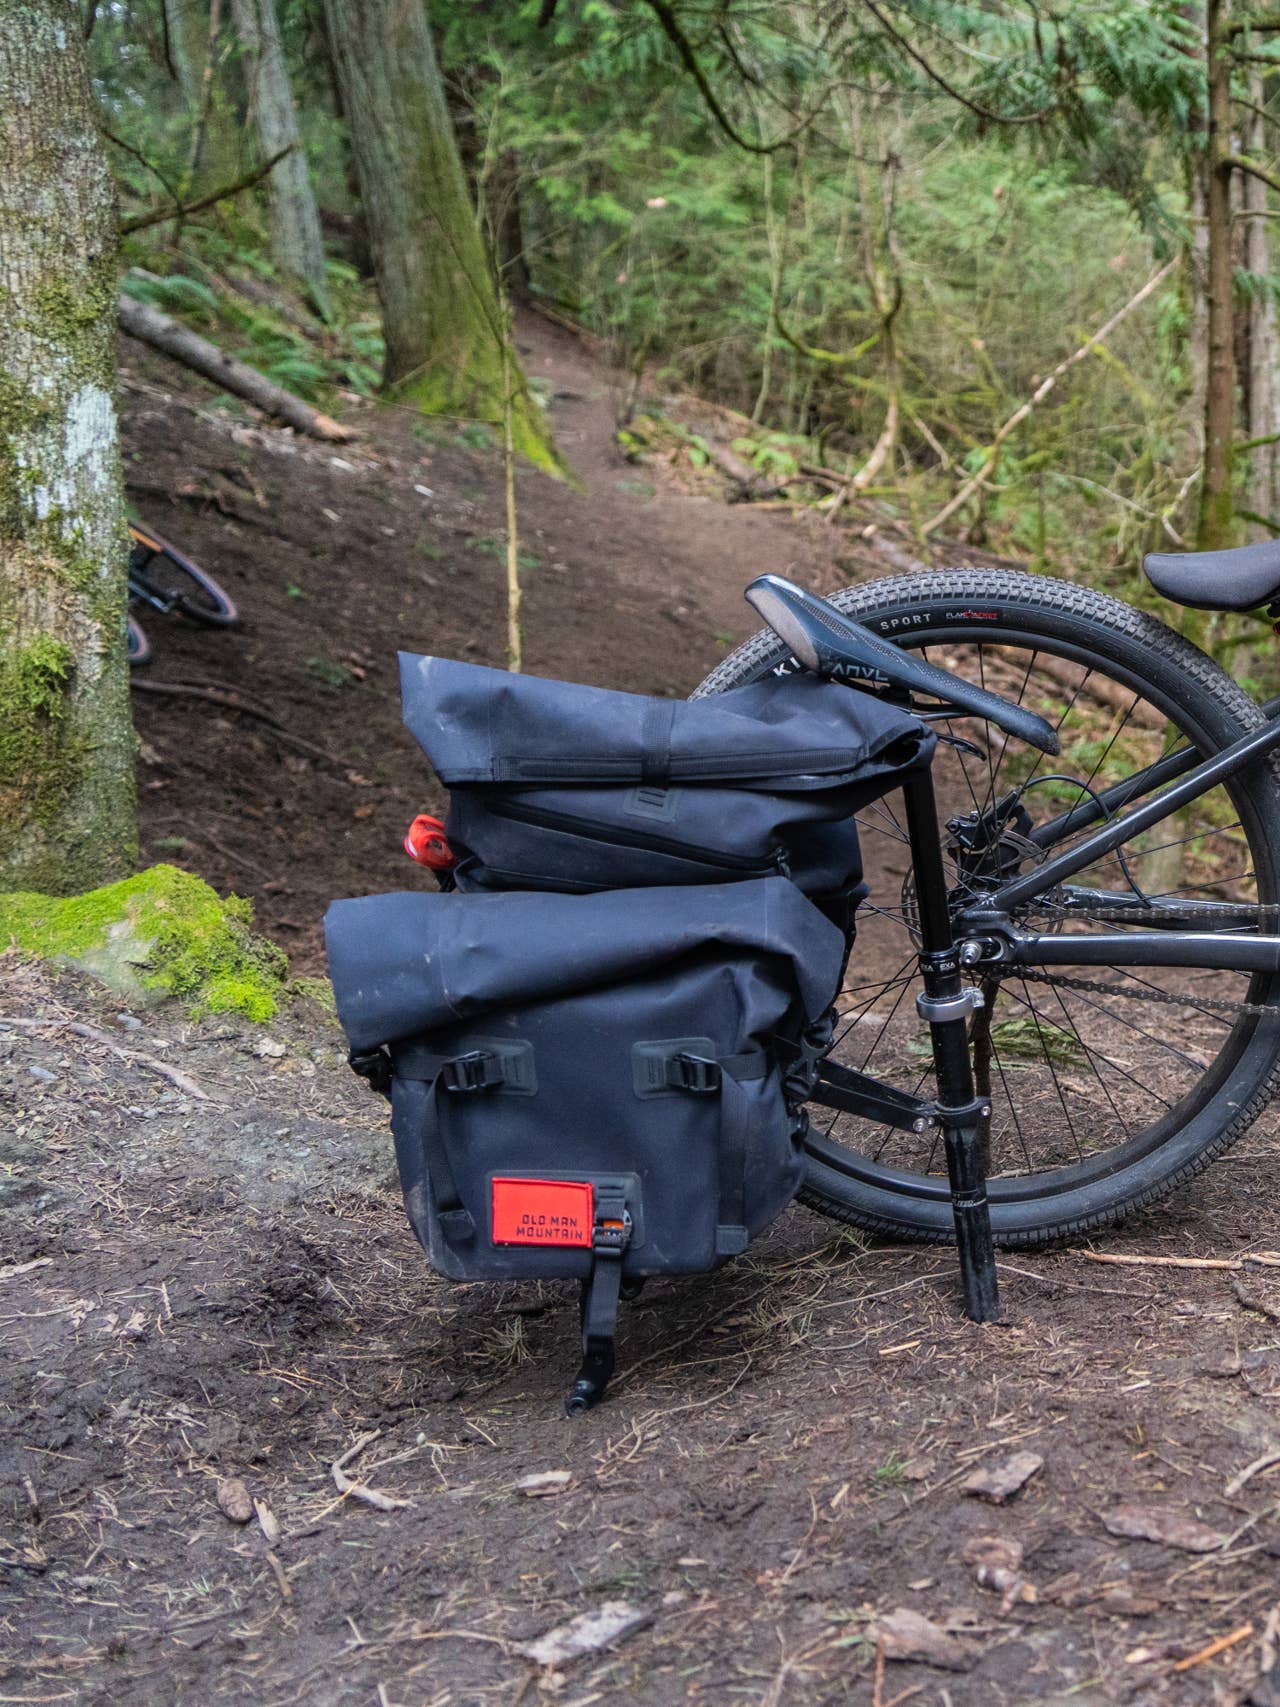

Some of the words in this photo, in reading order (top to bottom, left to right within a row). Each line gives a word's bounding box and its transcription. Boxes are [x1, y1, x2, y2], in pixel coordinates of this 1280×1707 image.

[880, 613, 932, 630] SPORT
[522, 1214, 546, 1226] OLD
[551, 1216, 578, 1227] MAN
[516, 1226, 584, 1240] MOUNTAIN
